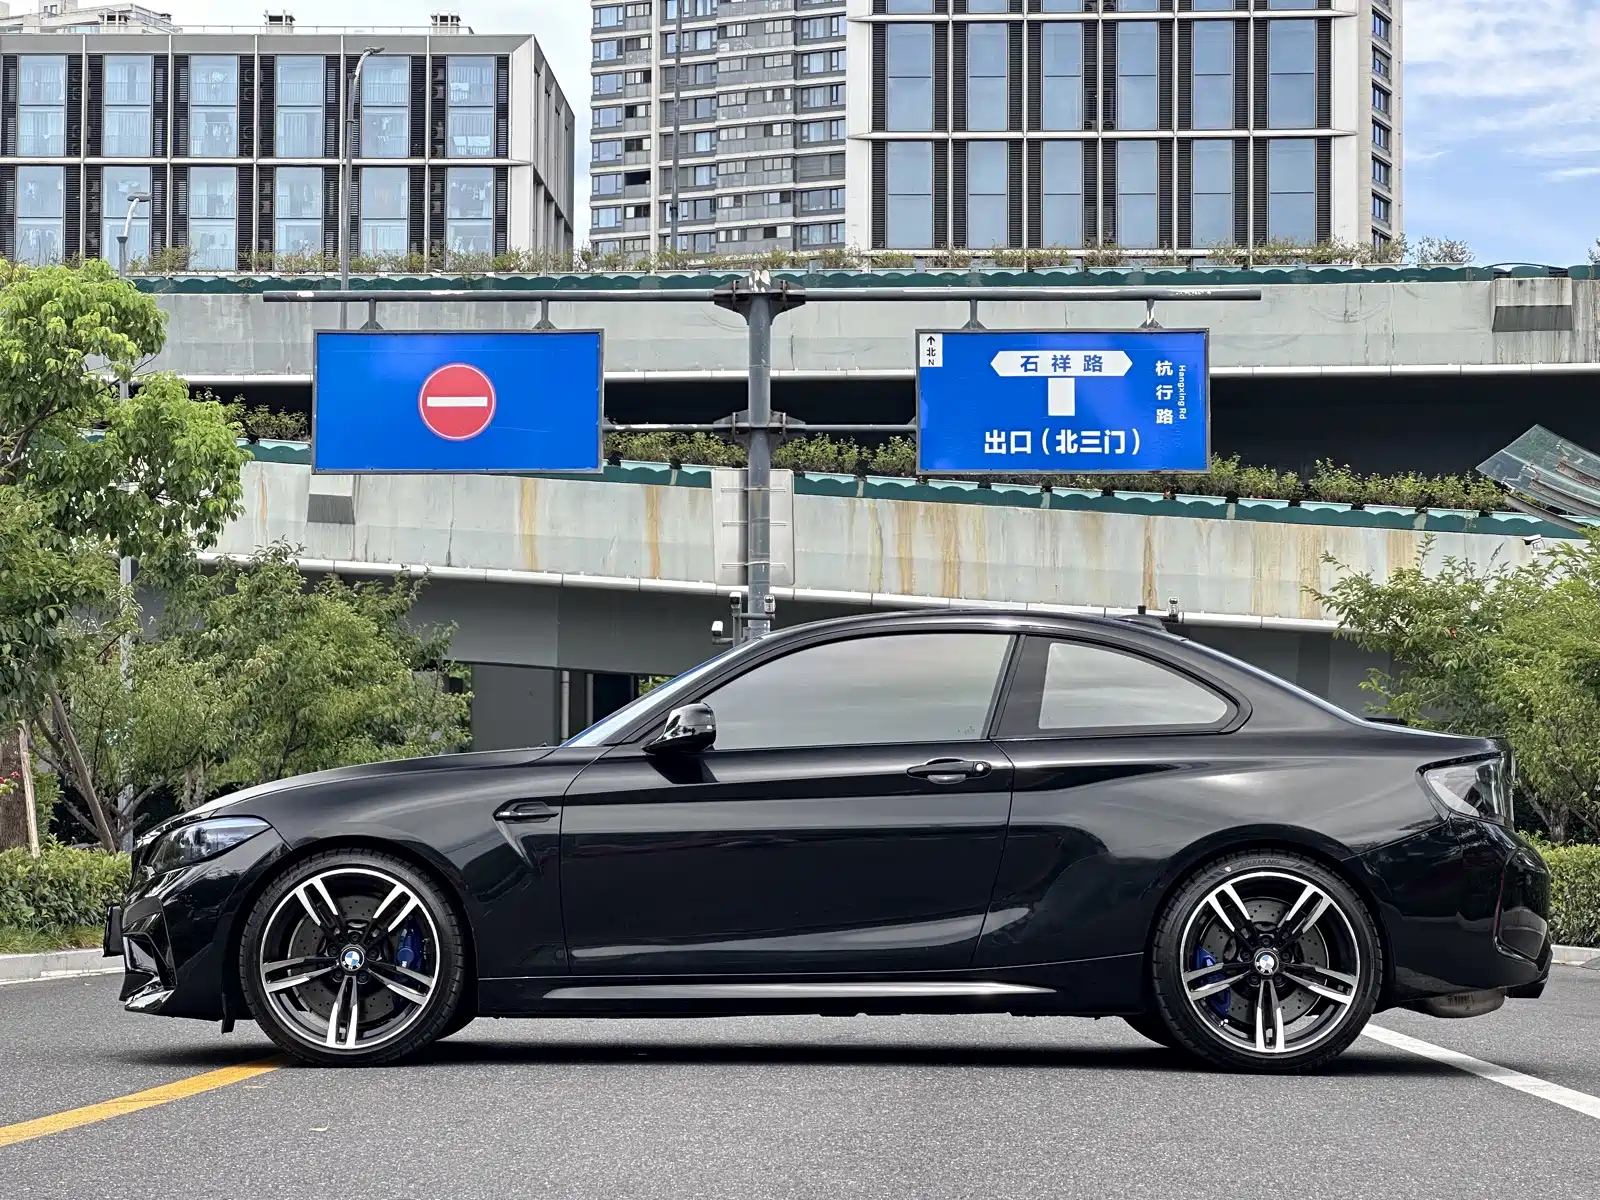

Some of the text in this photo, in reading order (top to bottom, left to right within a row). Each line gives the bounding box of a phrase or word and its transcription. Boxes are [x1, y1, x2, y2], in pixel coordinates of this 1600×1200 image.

[926, 347, 936, 357] 北
[1020, 354, 1104, 373] 石祥路
[1155, 360, 1173, 425] 杭行路
[1177, 365, 1187, 420] Hangxing Rd
